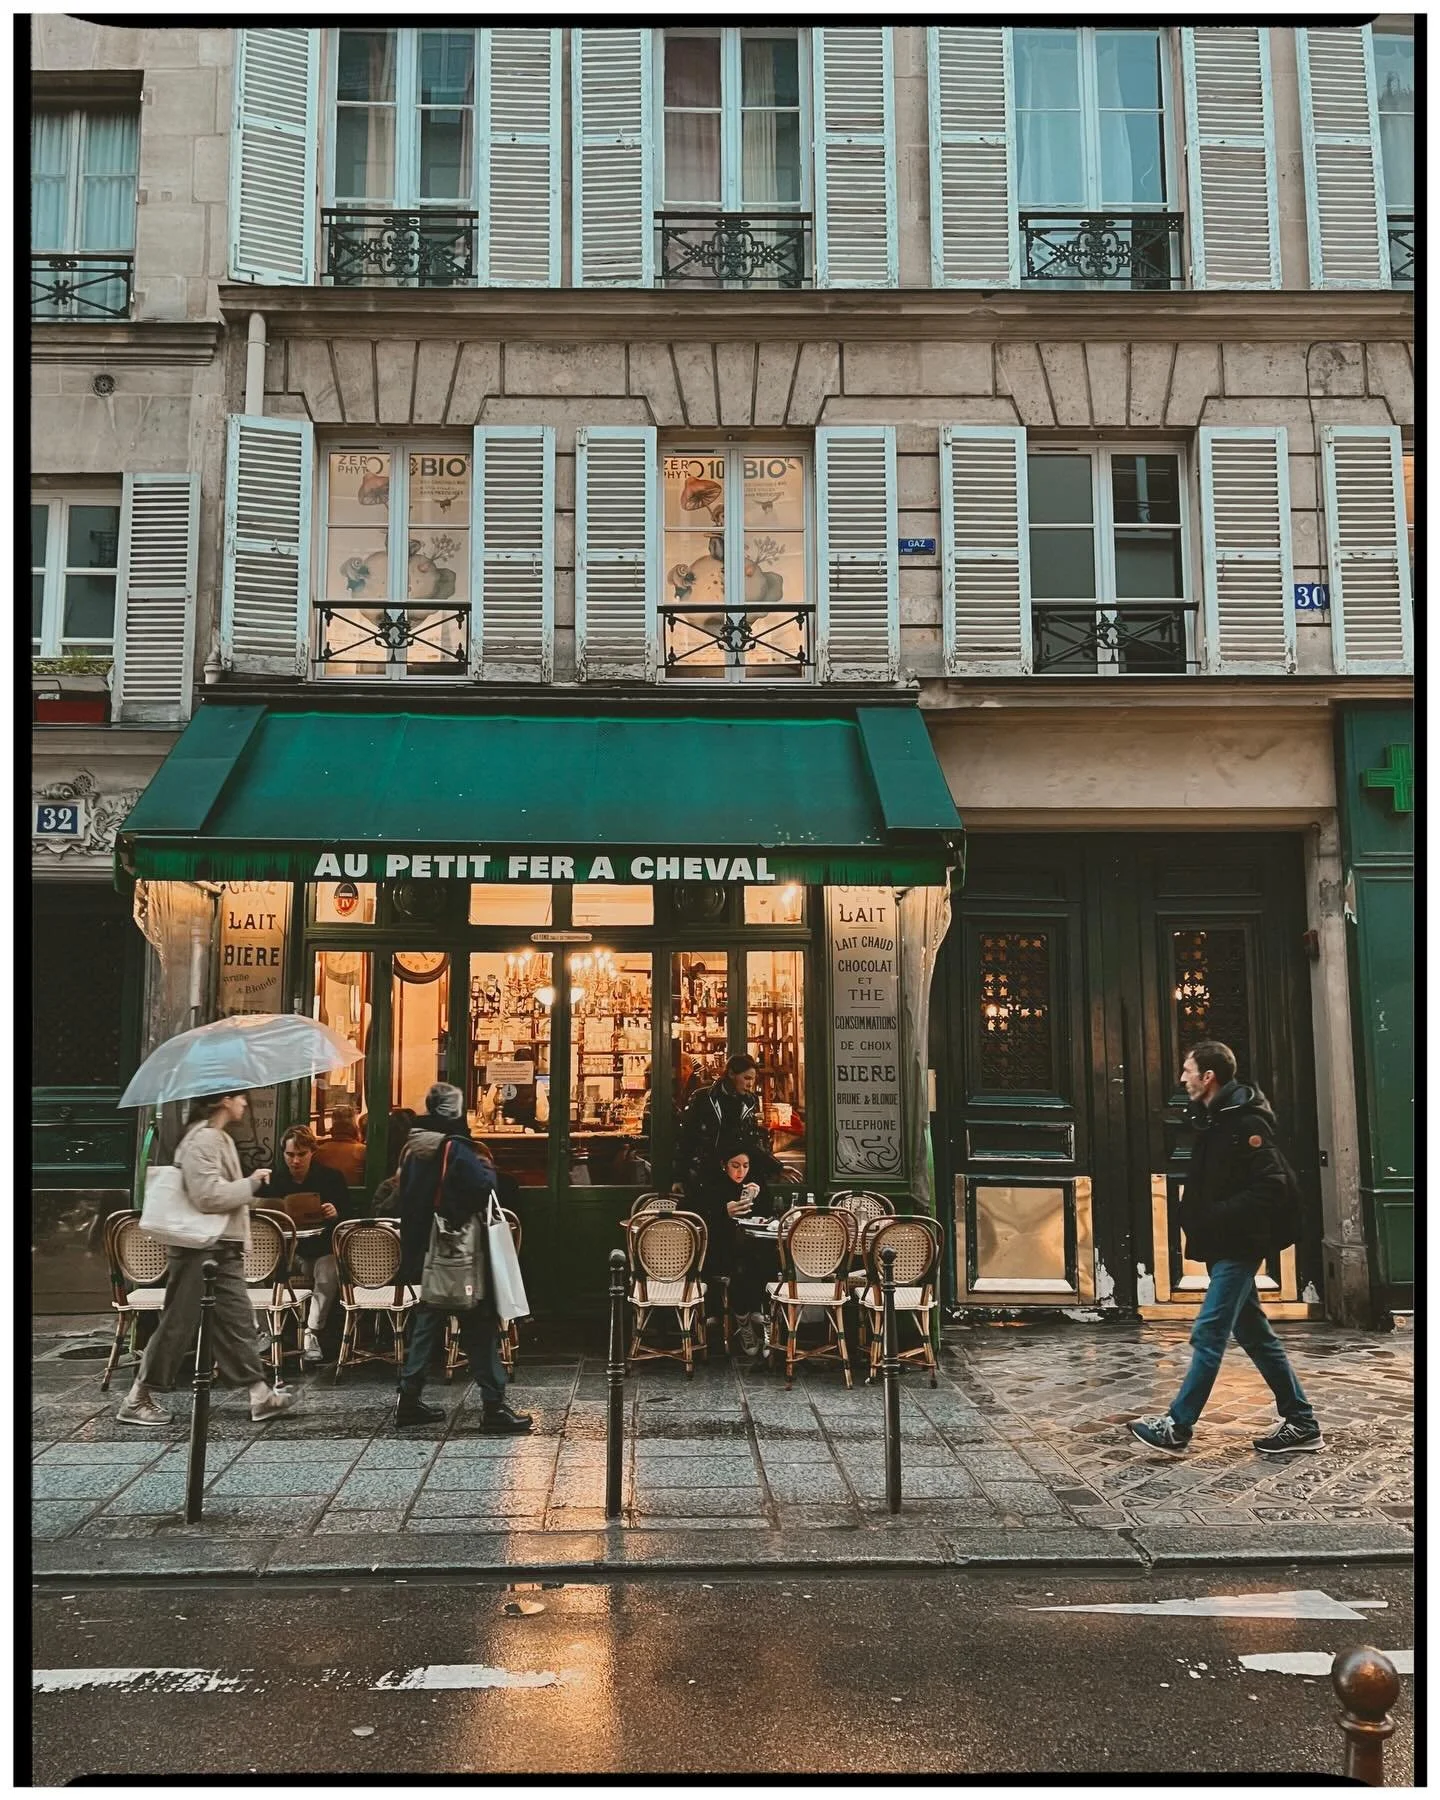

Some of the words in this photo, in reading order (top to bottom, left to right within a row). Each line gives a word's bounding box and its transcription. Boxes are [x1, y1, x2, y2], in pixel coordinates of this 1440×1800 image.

[421, 457, 466, 477] BIO
[743, 459, 787, 479] BIO
[1297, 586, 1326, 607] 30
[43, 808, 73, 830] 32
[314, 853, 368, 878] AU
[386, 854, 491, 879] PETIT
[508, 855, 575, 880] FER
[588, 856, 615, 880] A
[630, 855, 776, 882] CHEVAL
[228, 912, 276, 930] LAIT
[839, 904, 886, 923] LAIT
[835, 937, 858, 952] LAIT
[861, 936, 894, 951] CHAUD
[224, 944, 280, 967] BIÈRE
[838, 960, 893, 973] CHOCOLAT
[858, 977, 872, 985] ET
[848, 989, 885, 1001] THE
[835, 1016, 897, 1030] CONSOMMATIONS
[841, 1041, 854, 1050] DE
[860, 1041, 892, 1051] CHOIX
[837, 1065, 896, 1082] BIERE
[837, 1093, 862, 1105] BRUNE
[864, 1095, 871, 1105] &
[872, 1093, 898, 1105] BLONDE
[839, 1120, 897, 1131] TELEPHONE
